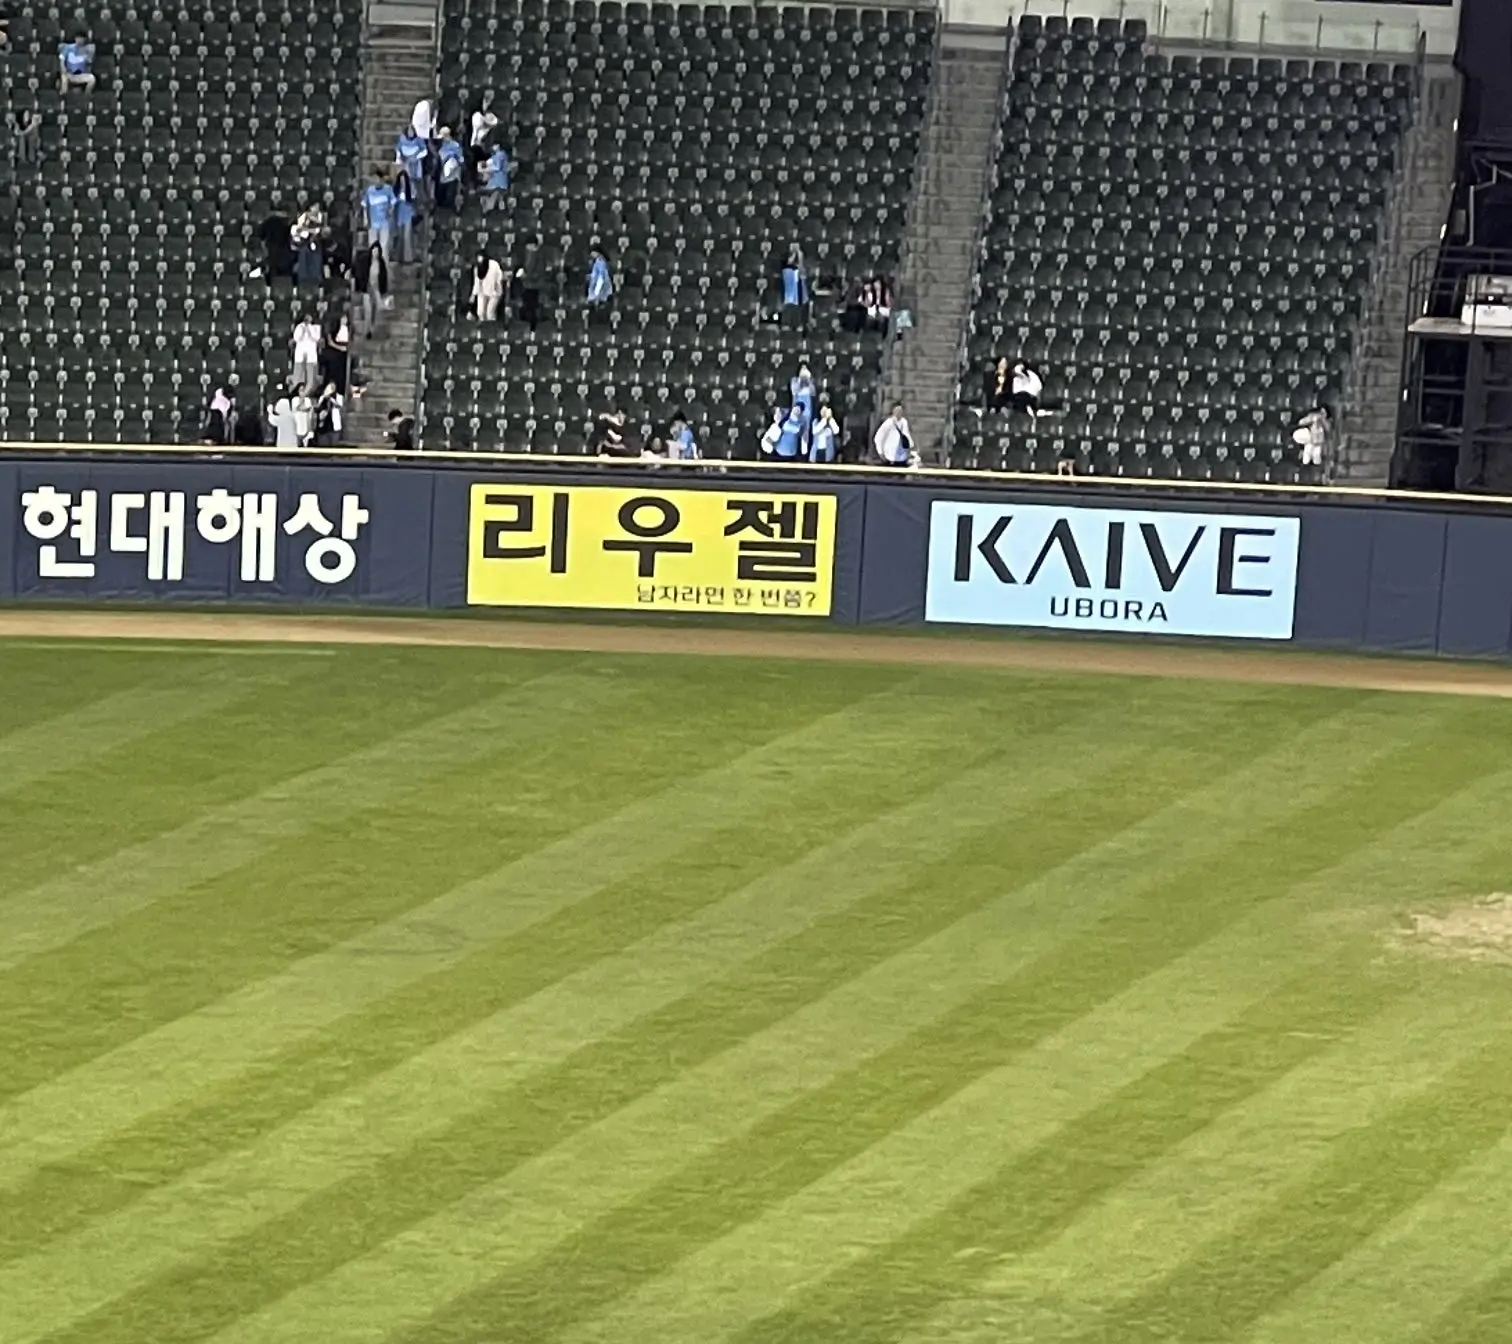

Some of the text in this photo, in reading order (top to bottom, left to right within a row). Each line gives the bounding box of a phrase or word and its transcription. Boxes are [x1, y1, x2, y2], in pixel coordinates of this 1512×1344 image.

[21, 486, 369, 584] 현대해상
[482, 492, 819, 582] 리우젤
[953, 514, 1276, 597] KAIVE
[734, 588, 751, 606] 한
[1050, 596, 1168, 622] UBORA
